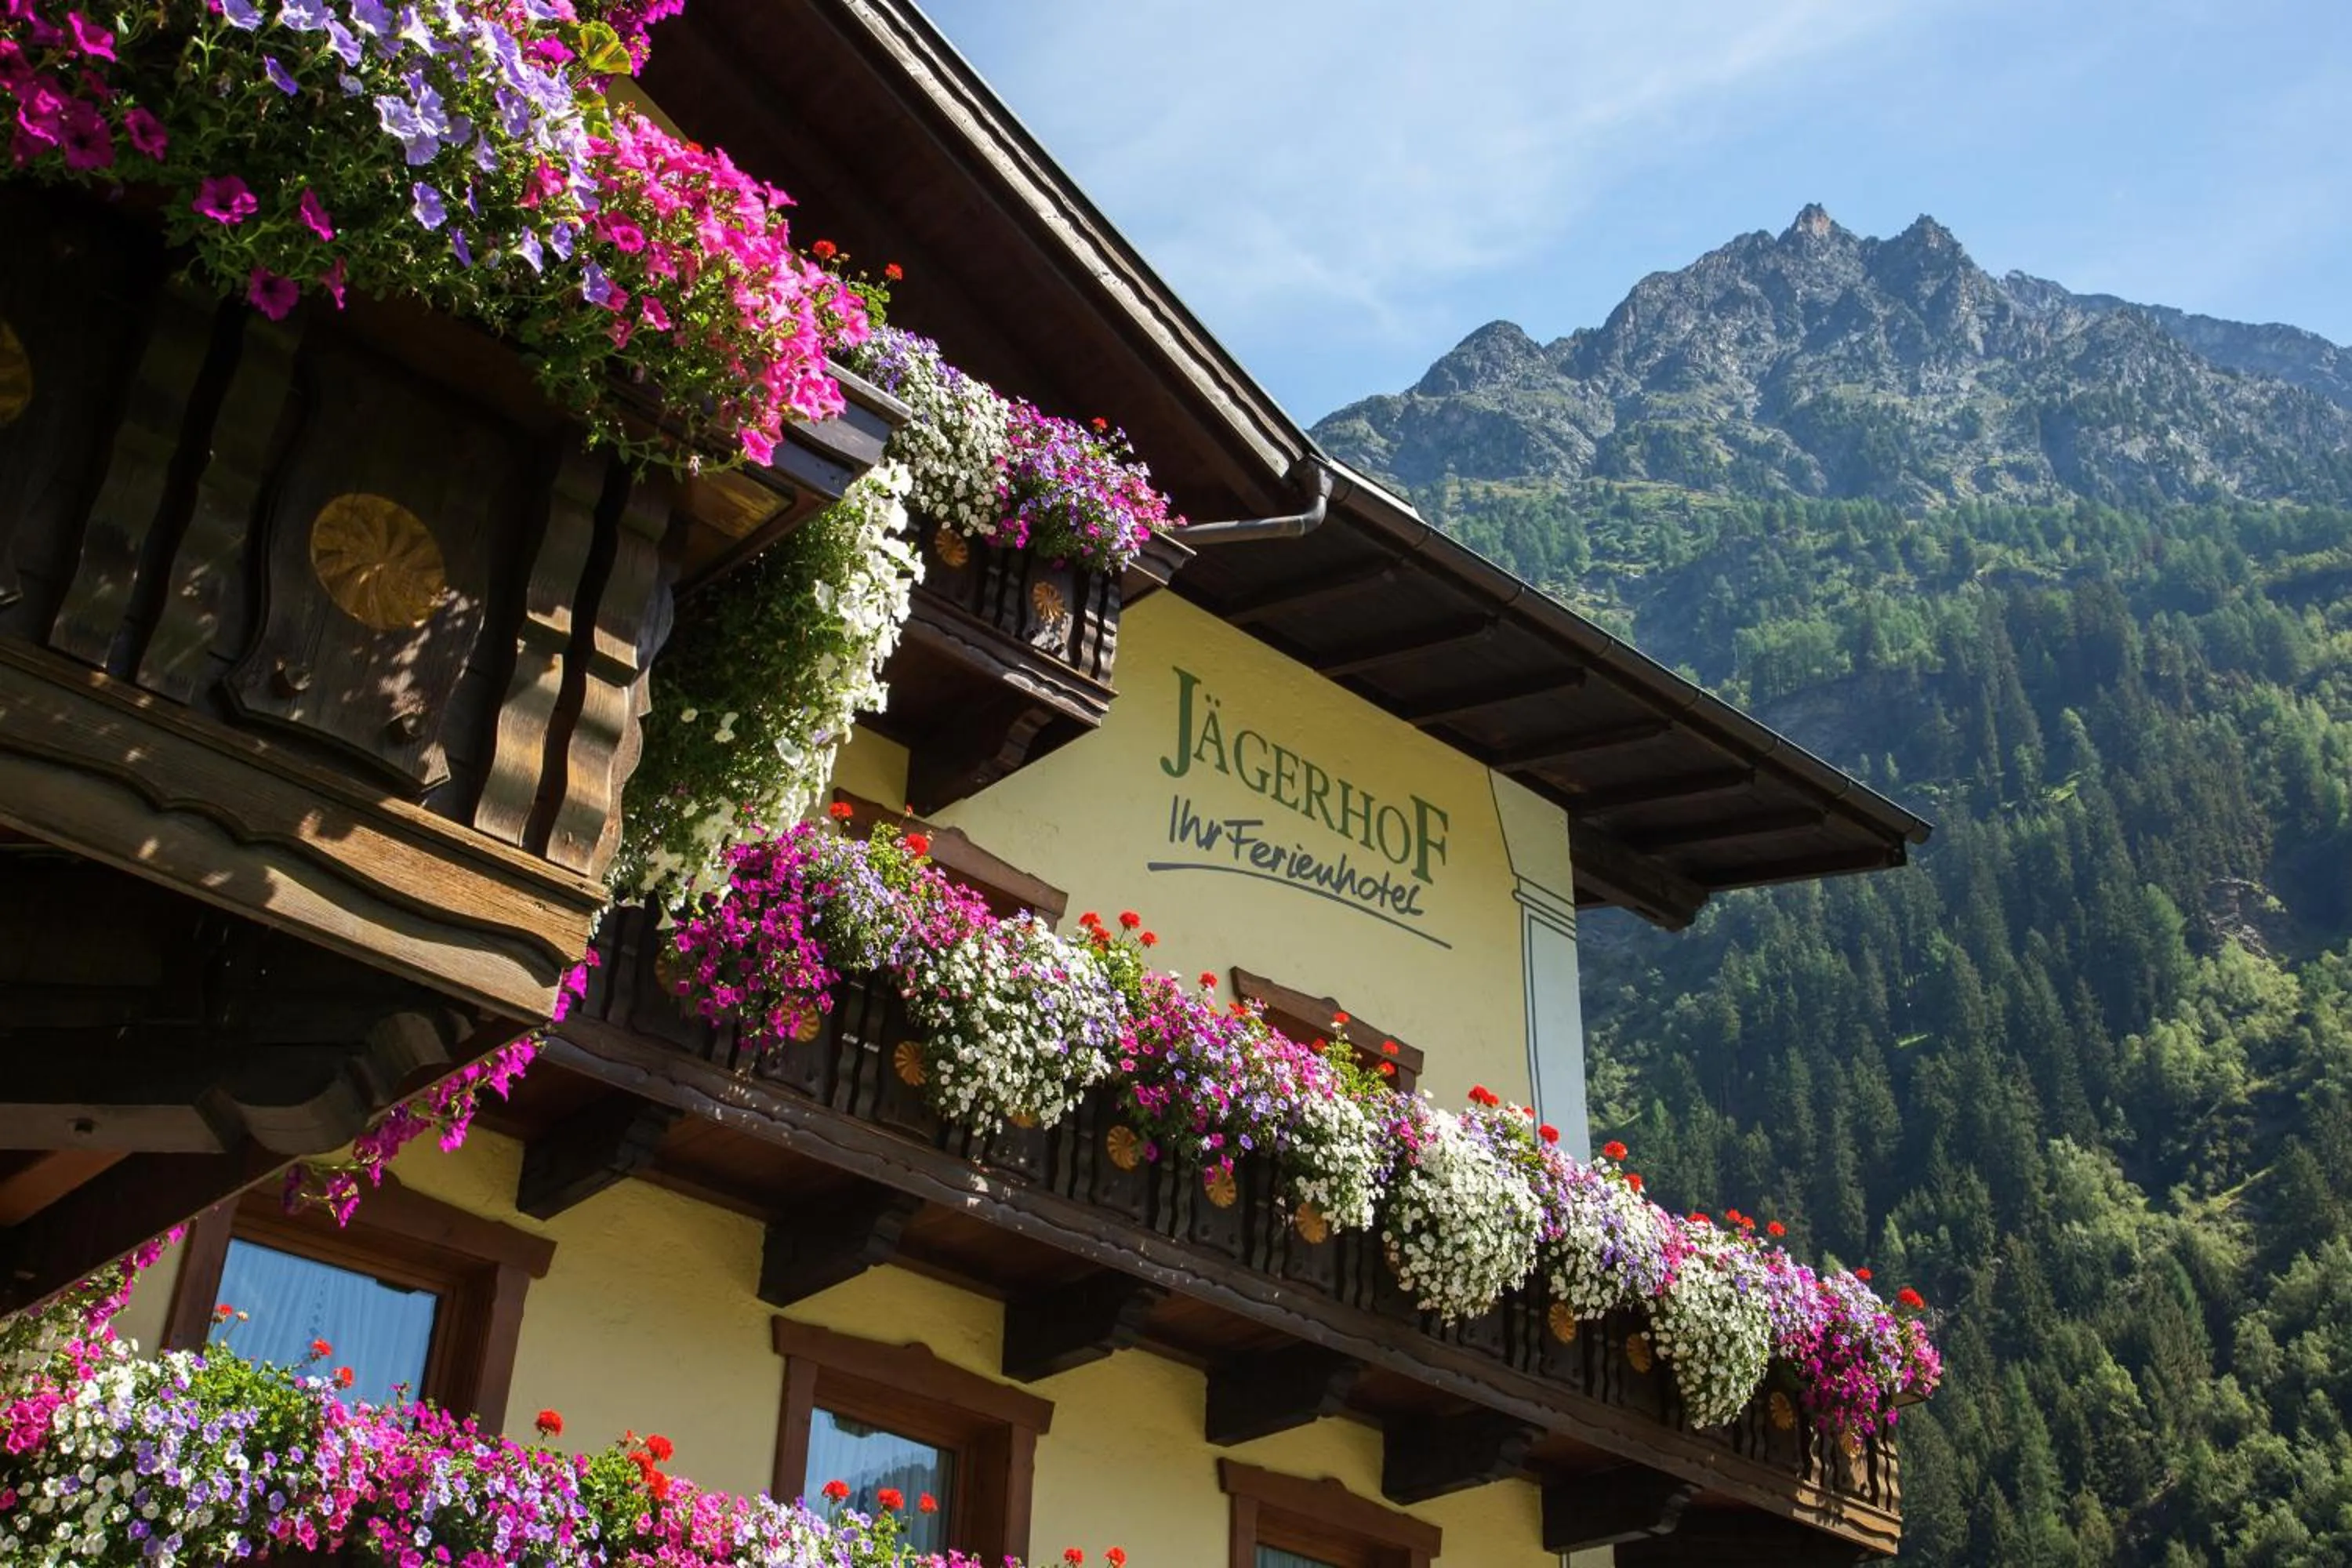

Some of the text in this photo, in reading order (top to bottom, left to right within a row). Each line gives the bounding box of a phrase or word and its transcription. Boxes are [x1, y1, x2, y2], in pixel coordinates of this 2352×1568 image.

[1160, 666, 1449, 885] JÄGERHOF
[1169, 794, 1424, 916] Ihr Ferienhotel
